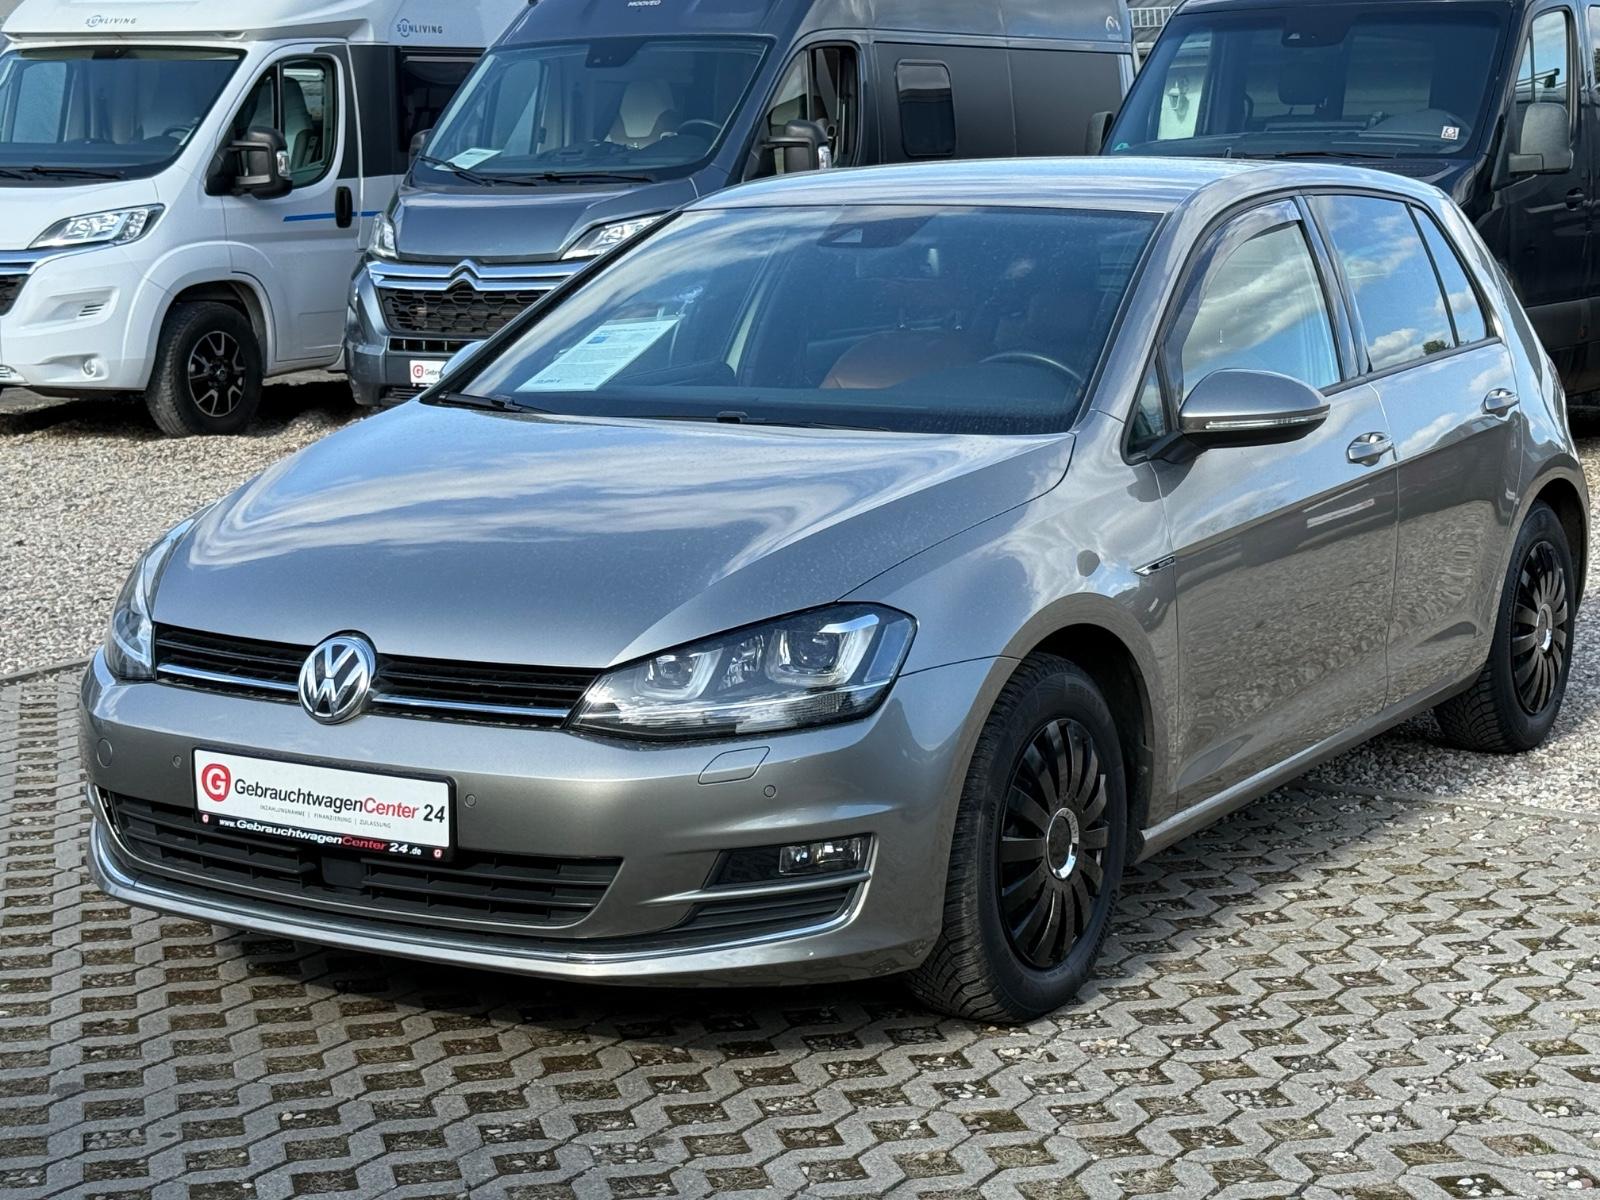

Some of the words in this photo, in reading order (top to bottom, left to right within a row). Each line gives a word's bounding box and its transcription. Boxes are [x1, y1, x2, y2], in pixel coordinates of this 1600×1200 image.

[396, 20, 443, 36] SUNLIVING
[206, 768, 227, 796] G
[234, 778, 419, 819] GebrauchtwagenCenter
[423, 803, 446, 823] 24
[314, 813, 352, 824] FINANZIERUNG
[359, 819, 392, 829] ZULASSUNG
